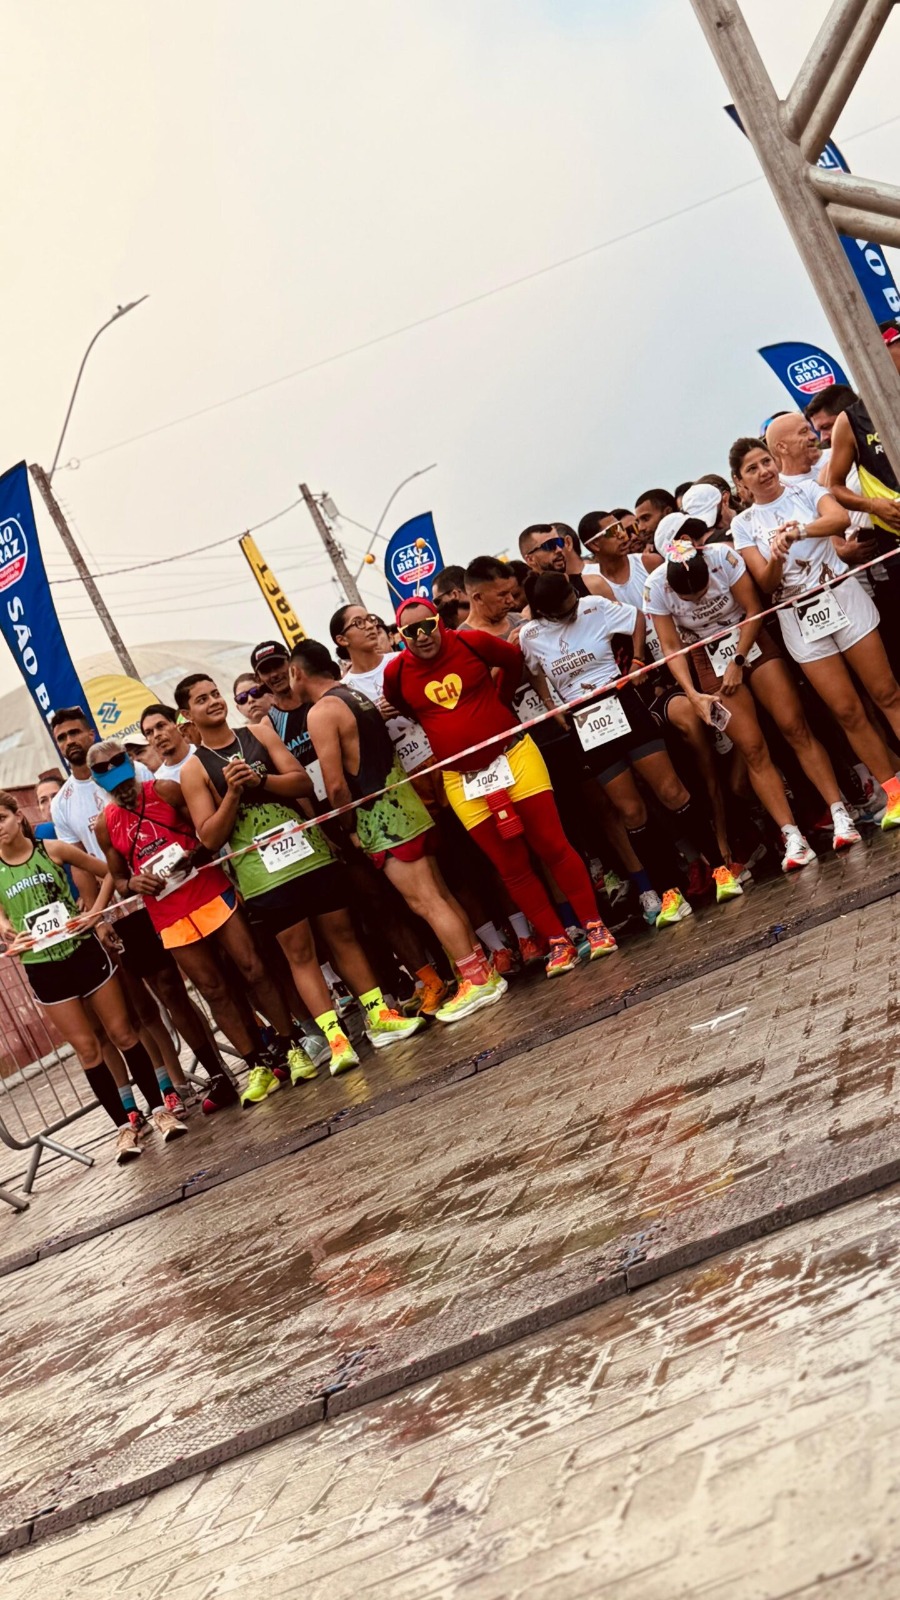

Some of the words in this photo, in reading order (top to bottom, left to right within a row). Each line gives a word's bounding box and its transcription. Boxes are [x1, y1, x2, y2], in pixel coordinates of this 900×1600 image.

[795, 365, 828, 384] BRAZ
[397, 552, 430, 573] BRAZ
[806, 607, 830, 627] 5007
[7, 596, 38, 676] SÃO
[551, 652, 597, 678] FOGUEIRA
[433, 682, 458, 703] CH
[588, 714, 613, 733] 1002
[397, 740, 419, 760] 5326
[476, 770, 498, 788] 1005
[271, 836, 296, 855] 5272
[5, 872, 55, 900] HARRIERS
[36, 917, 60, 935] 5278
